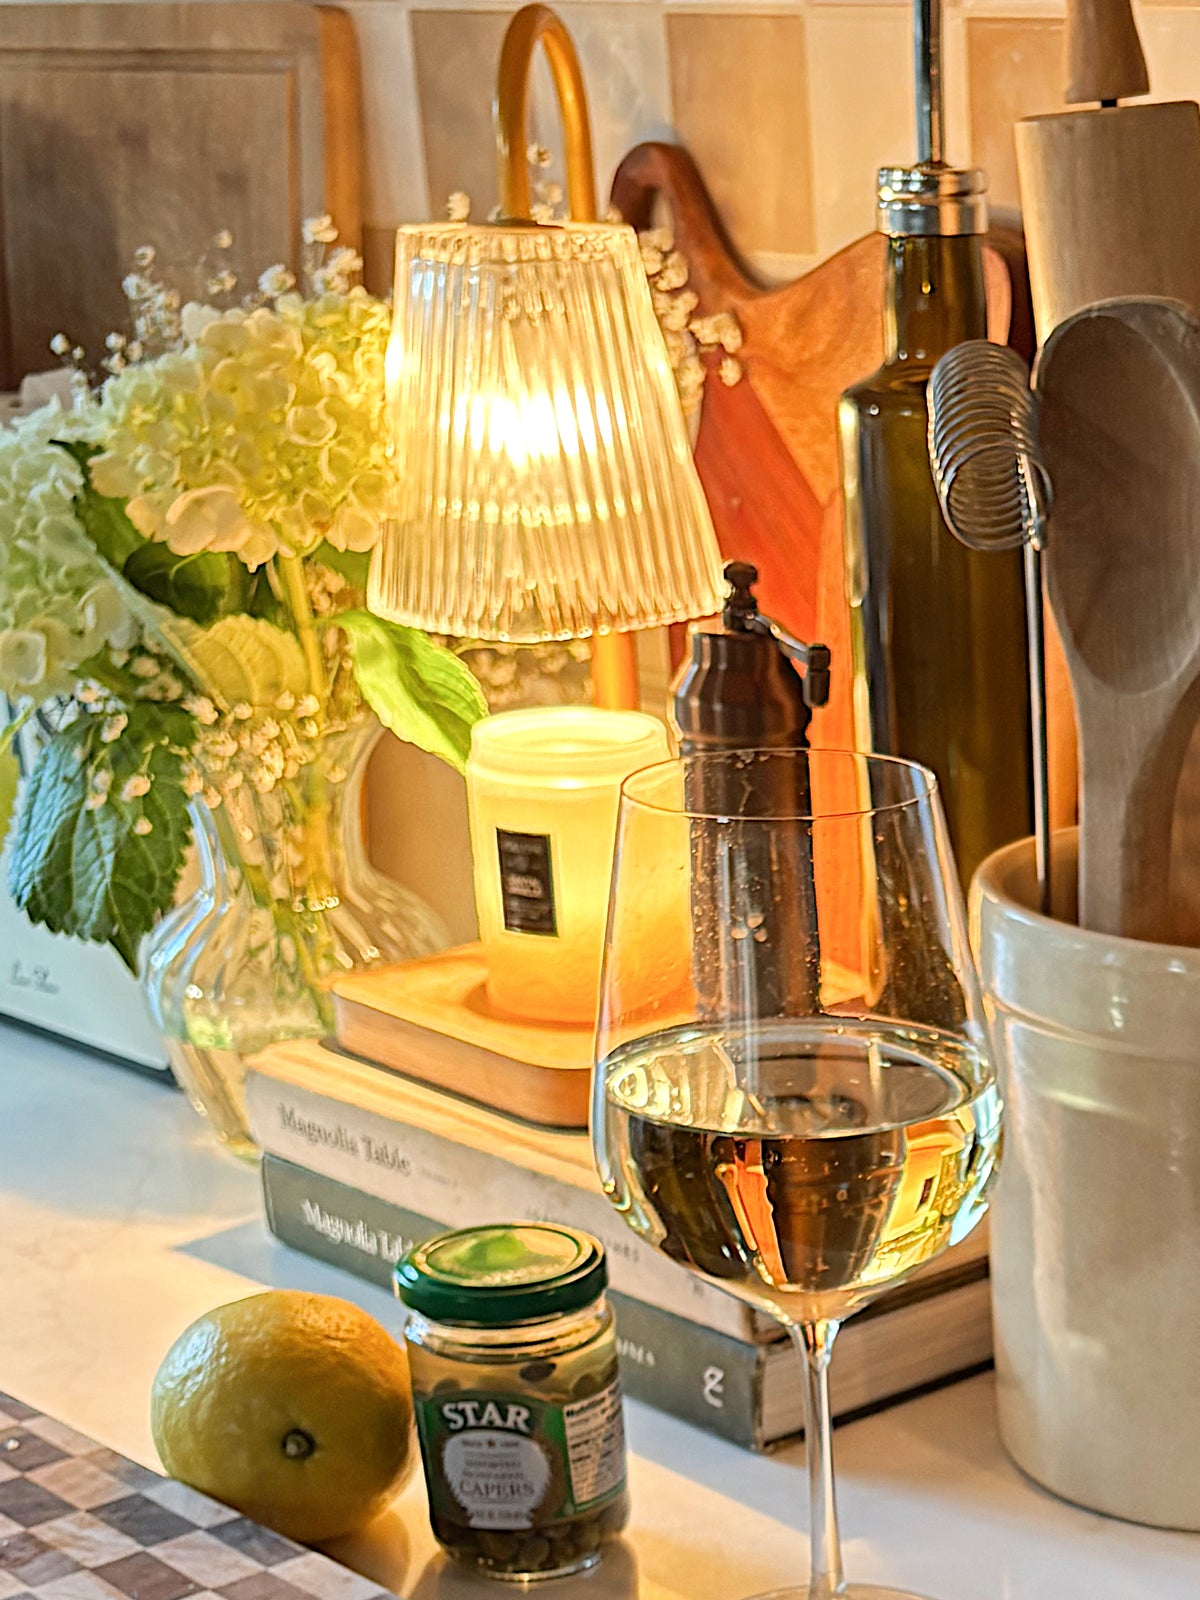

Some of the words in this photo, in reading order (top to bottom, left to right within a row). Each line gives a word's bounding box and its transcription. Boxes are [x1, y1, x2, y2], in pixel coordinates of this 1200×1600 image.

[277, 1102, 359, 1157] Magnolia
[361, 1133, 411, 1176] Table
[302, 1198, 378, 1256] Magnolia
[442, 1400, 531, 1433] STAR
